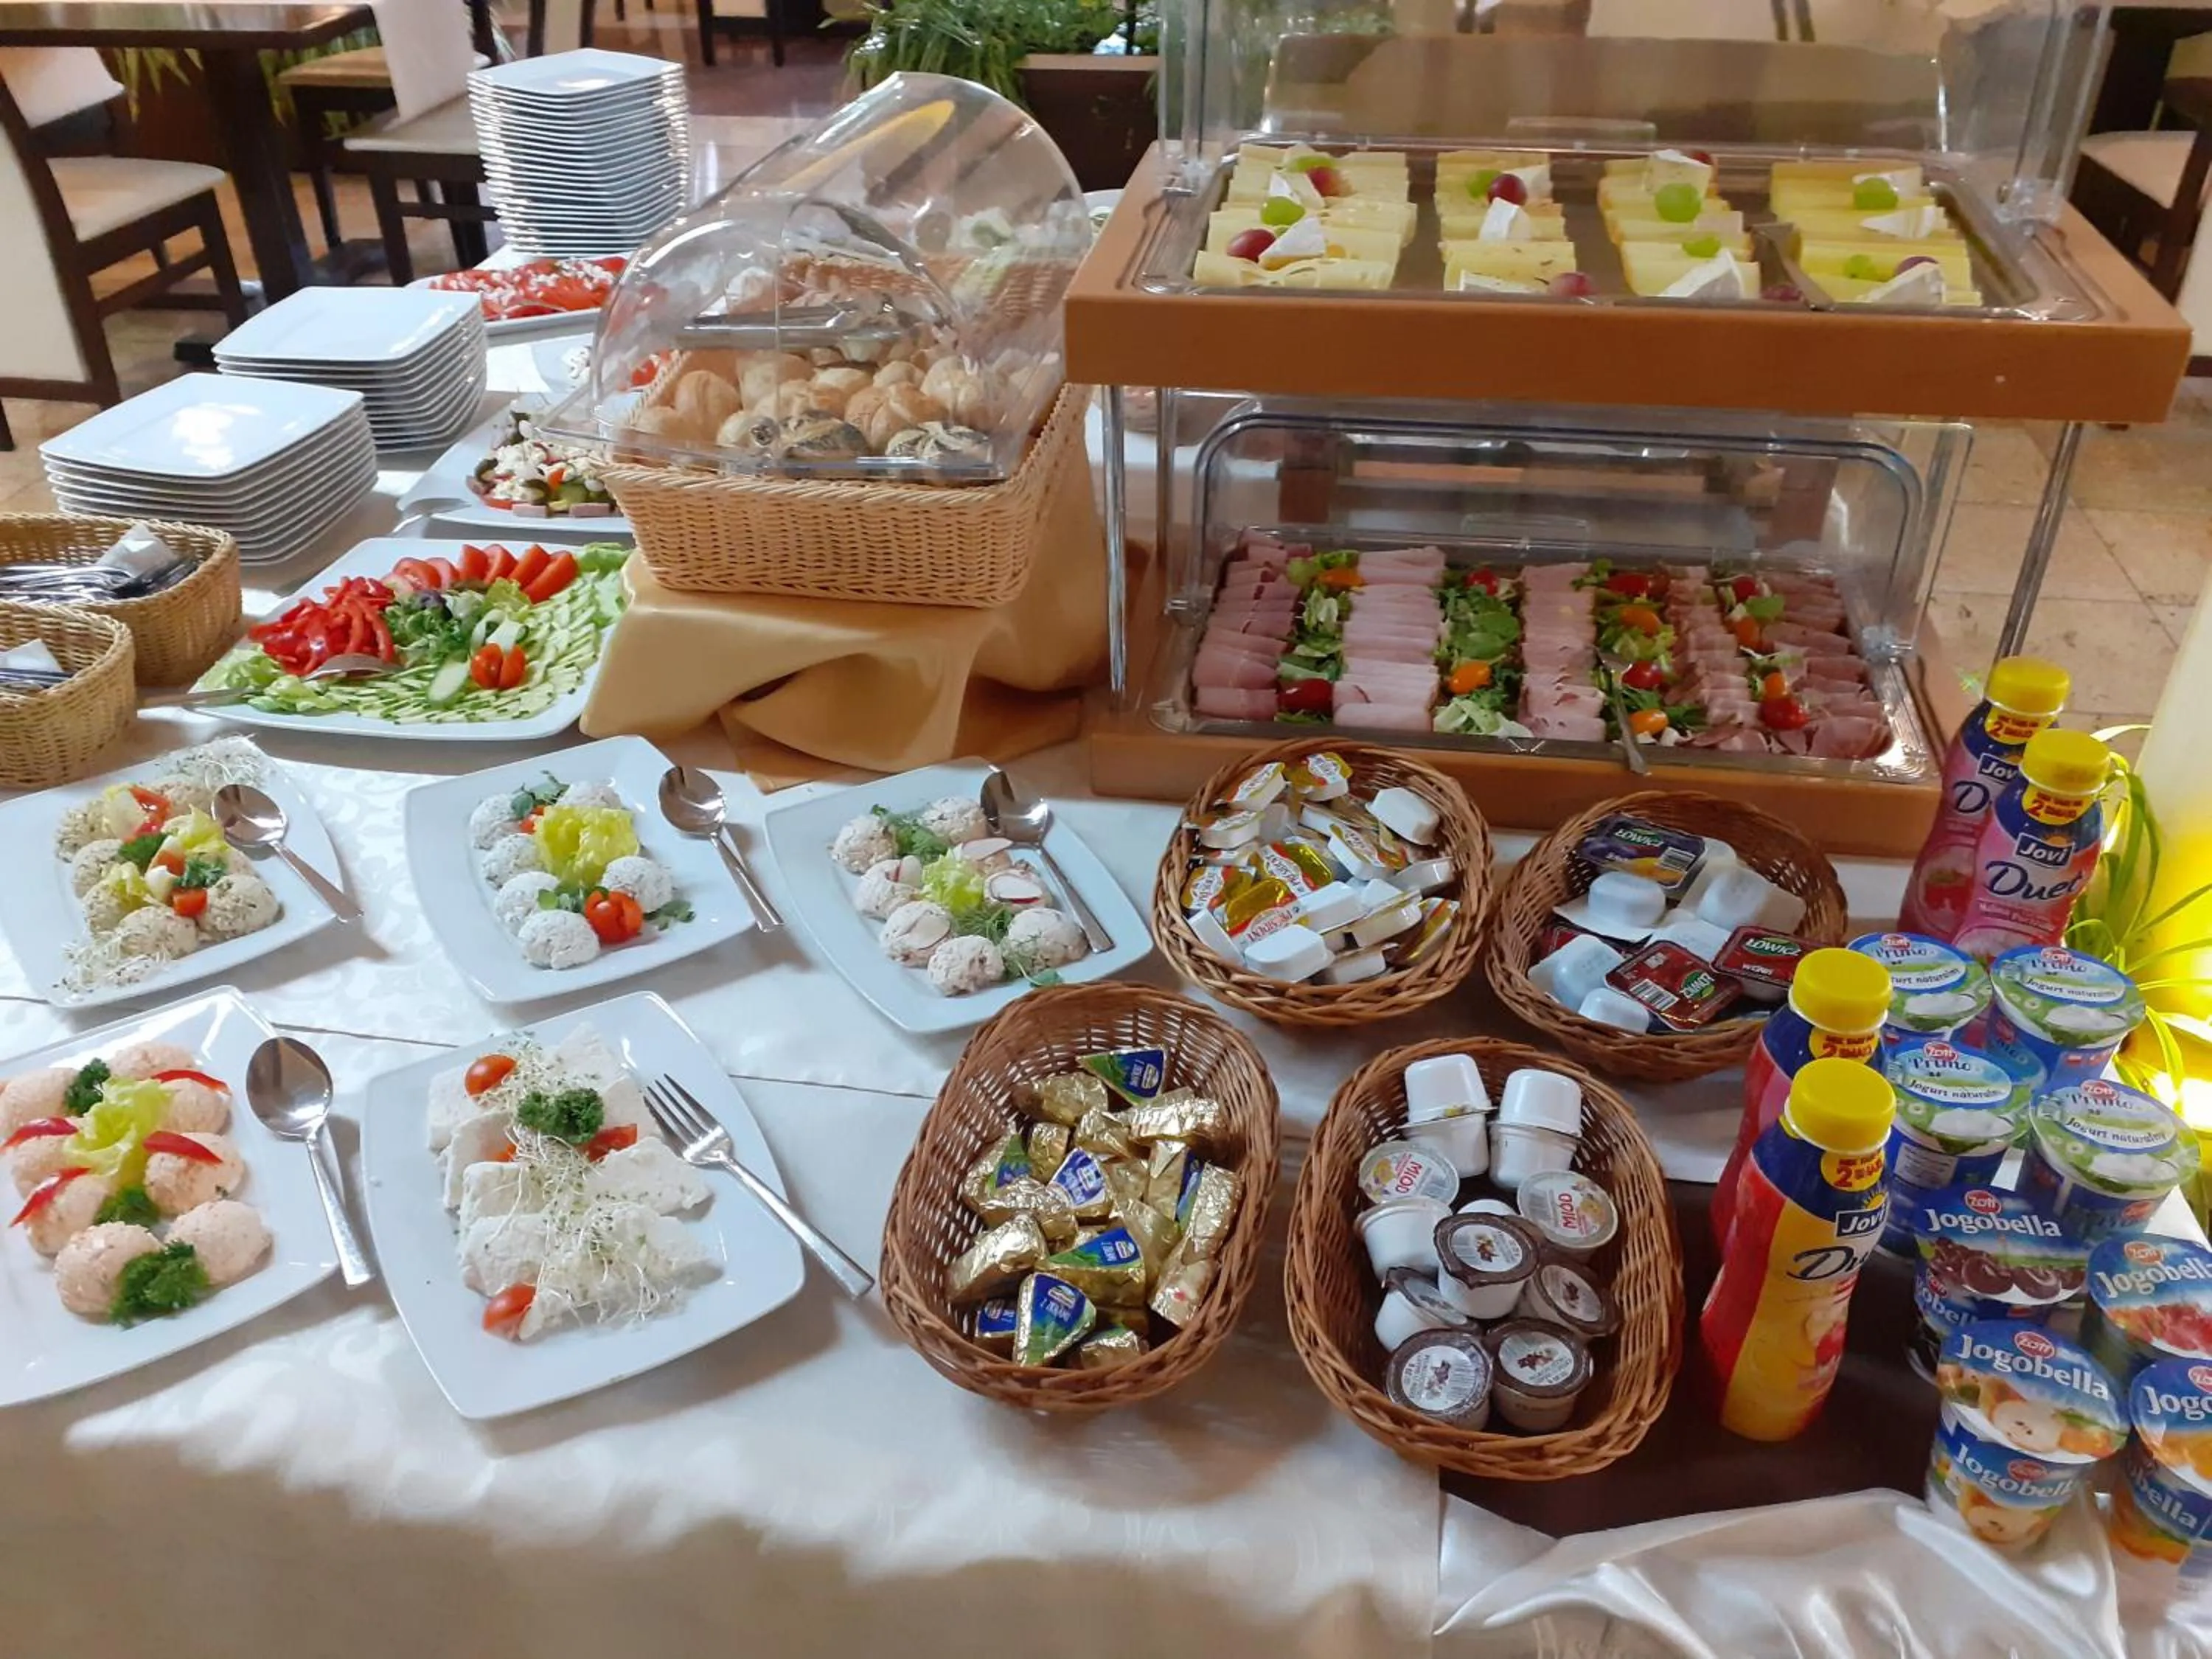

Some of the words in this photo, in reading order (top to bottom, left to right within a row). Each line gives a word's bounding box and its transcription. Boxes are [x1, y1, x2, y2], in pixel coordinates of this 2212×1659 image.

[1981, 762, 2020, 779] Jov
[2020, 843, 2067, 863] Jovi
[1983, 860, 2084, 900] Duet
[2027, 978, 2064, 994] Jogurt
[1910, 1079, 1948, 1096] Jogurt
[2066, 1116, 2107, 1139] Jogurt
[1834, 1167, 1854, 1188] 2
[1969, 1196, 1997, 1208] Zott
[1924, 1208, 2062, 1237] Jogobella
[1786, 1245, 1870, 1281] Du
[2018, 1338, 2051, 1354] Zott
[1958, 1334, 2110, 1400] Jogobella
[1956, 1443, 2072, 1498] Jogobell
